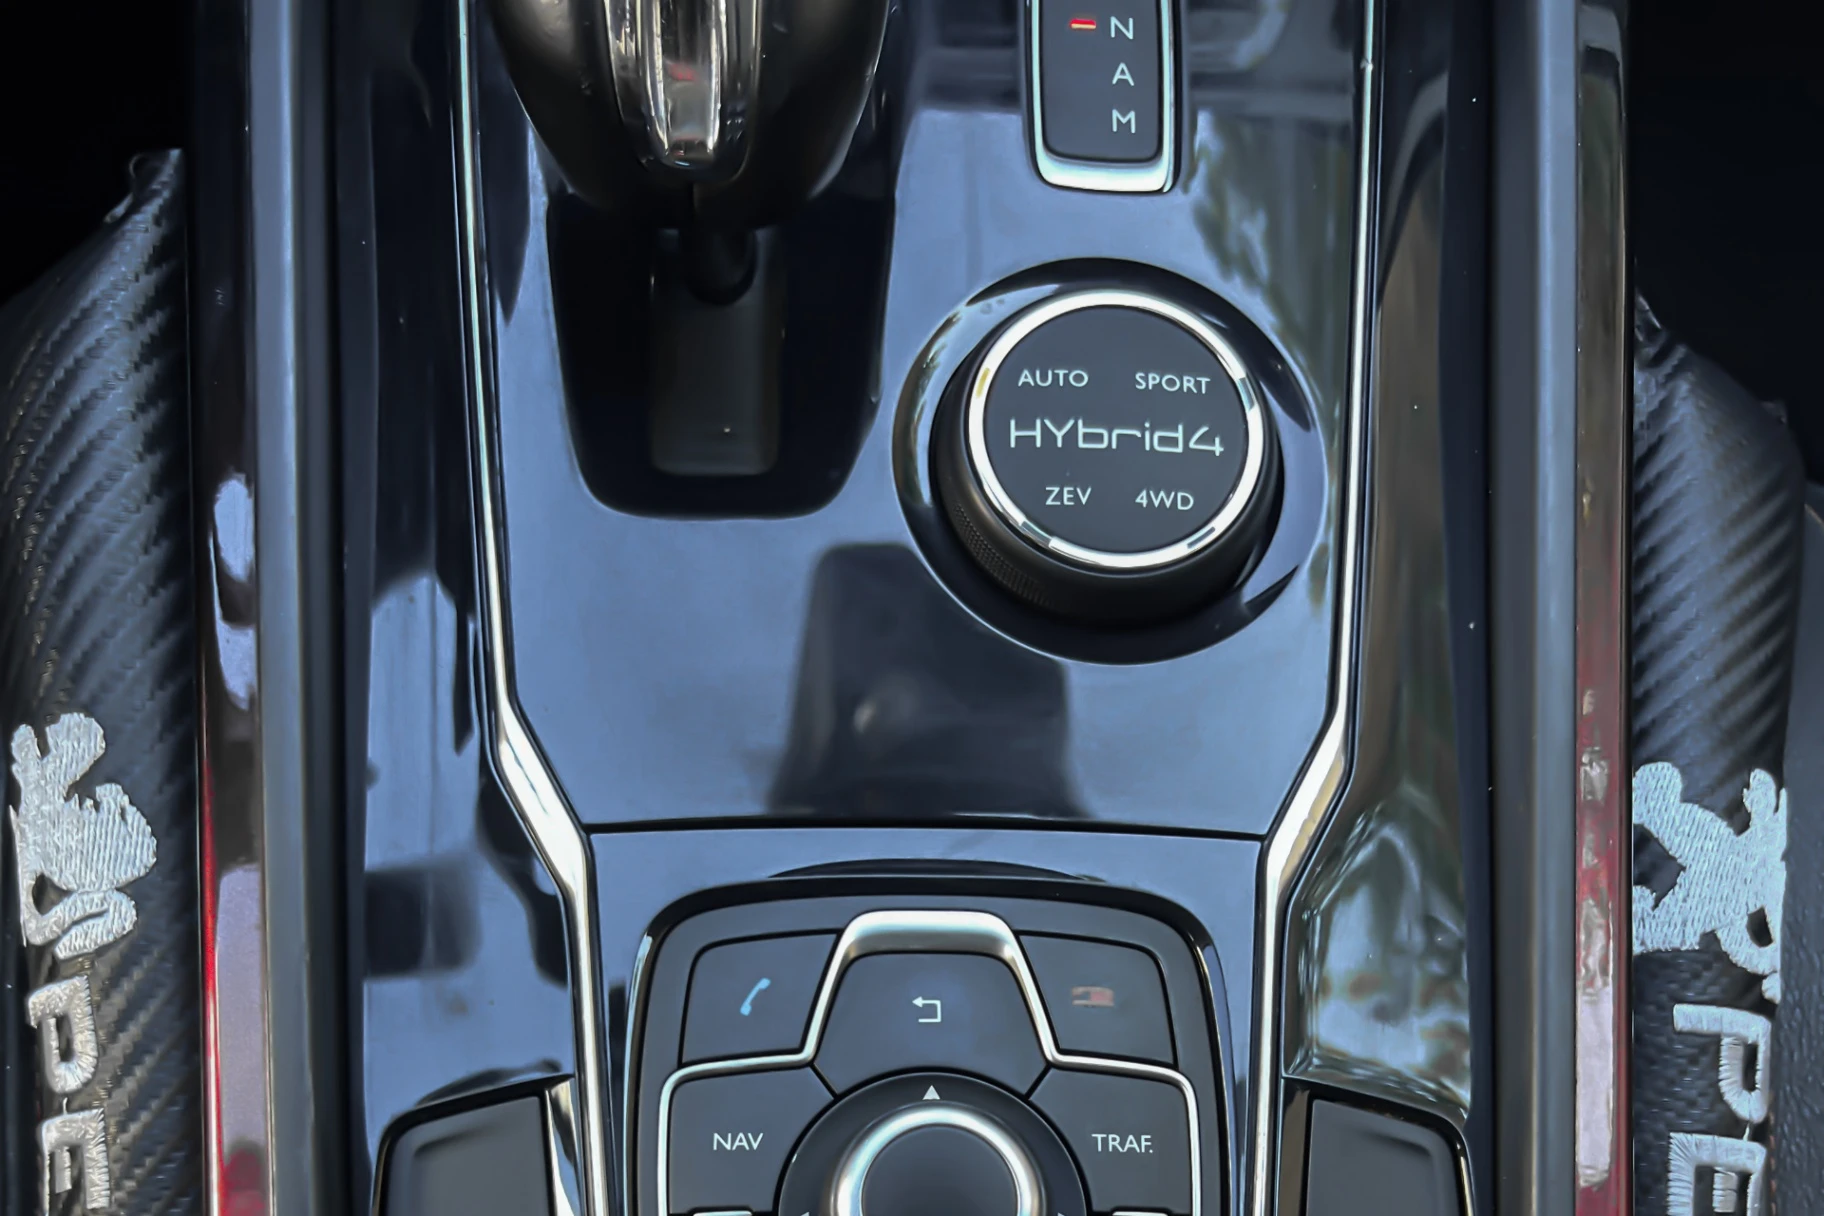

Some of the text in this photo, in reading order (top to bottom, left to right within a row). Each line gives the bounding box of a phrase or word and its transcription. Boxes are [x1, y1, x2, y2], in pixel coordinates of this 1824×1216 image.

[1109, 15, 1134, 40] N
[1112, 62, 1135, 87] A
[1112, 109, 1137, 135] M
[1018, 368, 1089, 388] AUTO
[1135, 372, 1211, 395] SPORT
[1045, 486, 1092, 506] ZEV
[1135, 489, 1195, 512] 4WD
[712, 1132, 764, 1152] NAV
[1091, 1133, 1153, 1154] TRAF.
